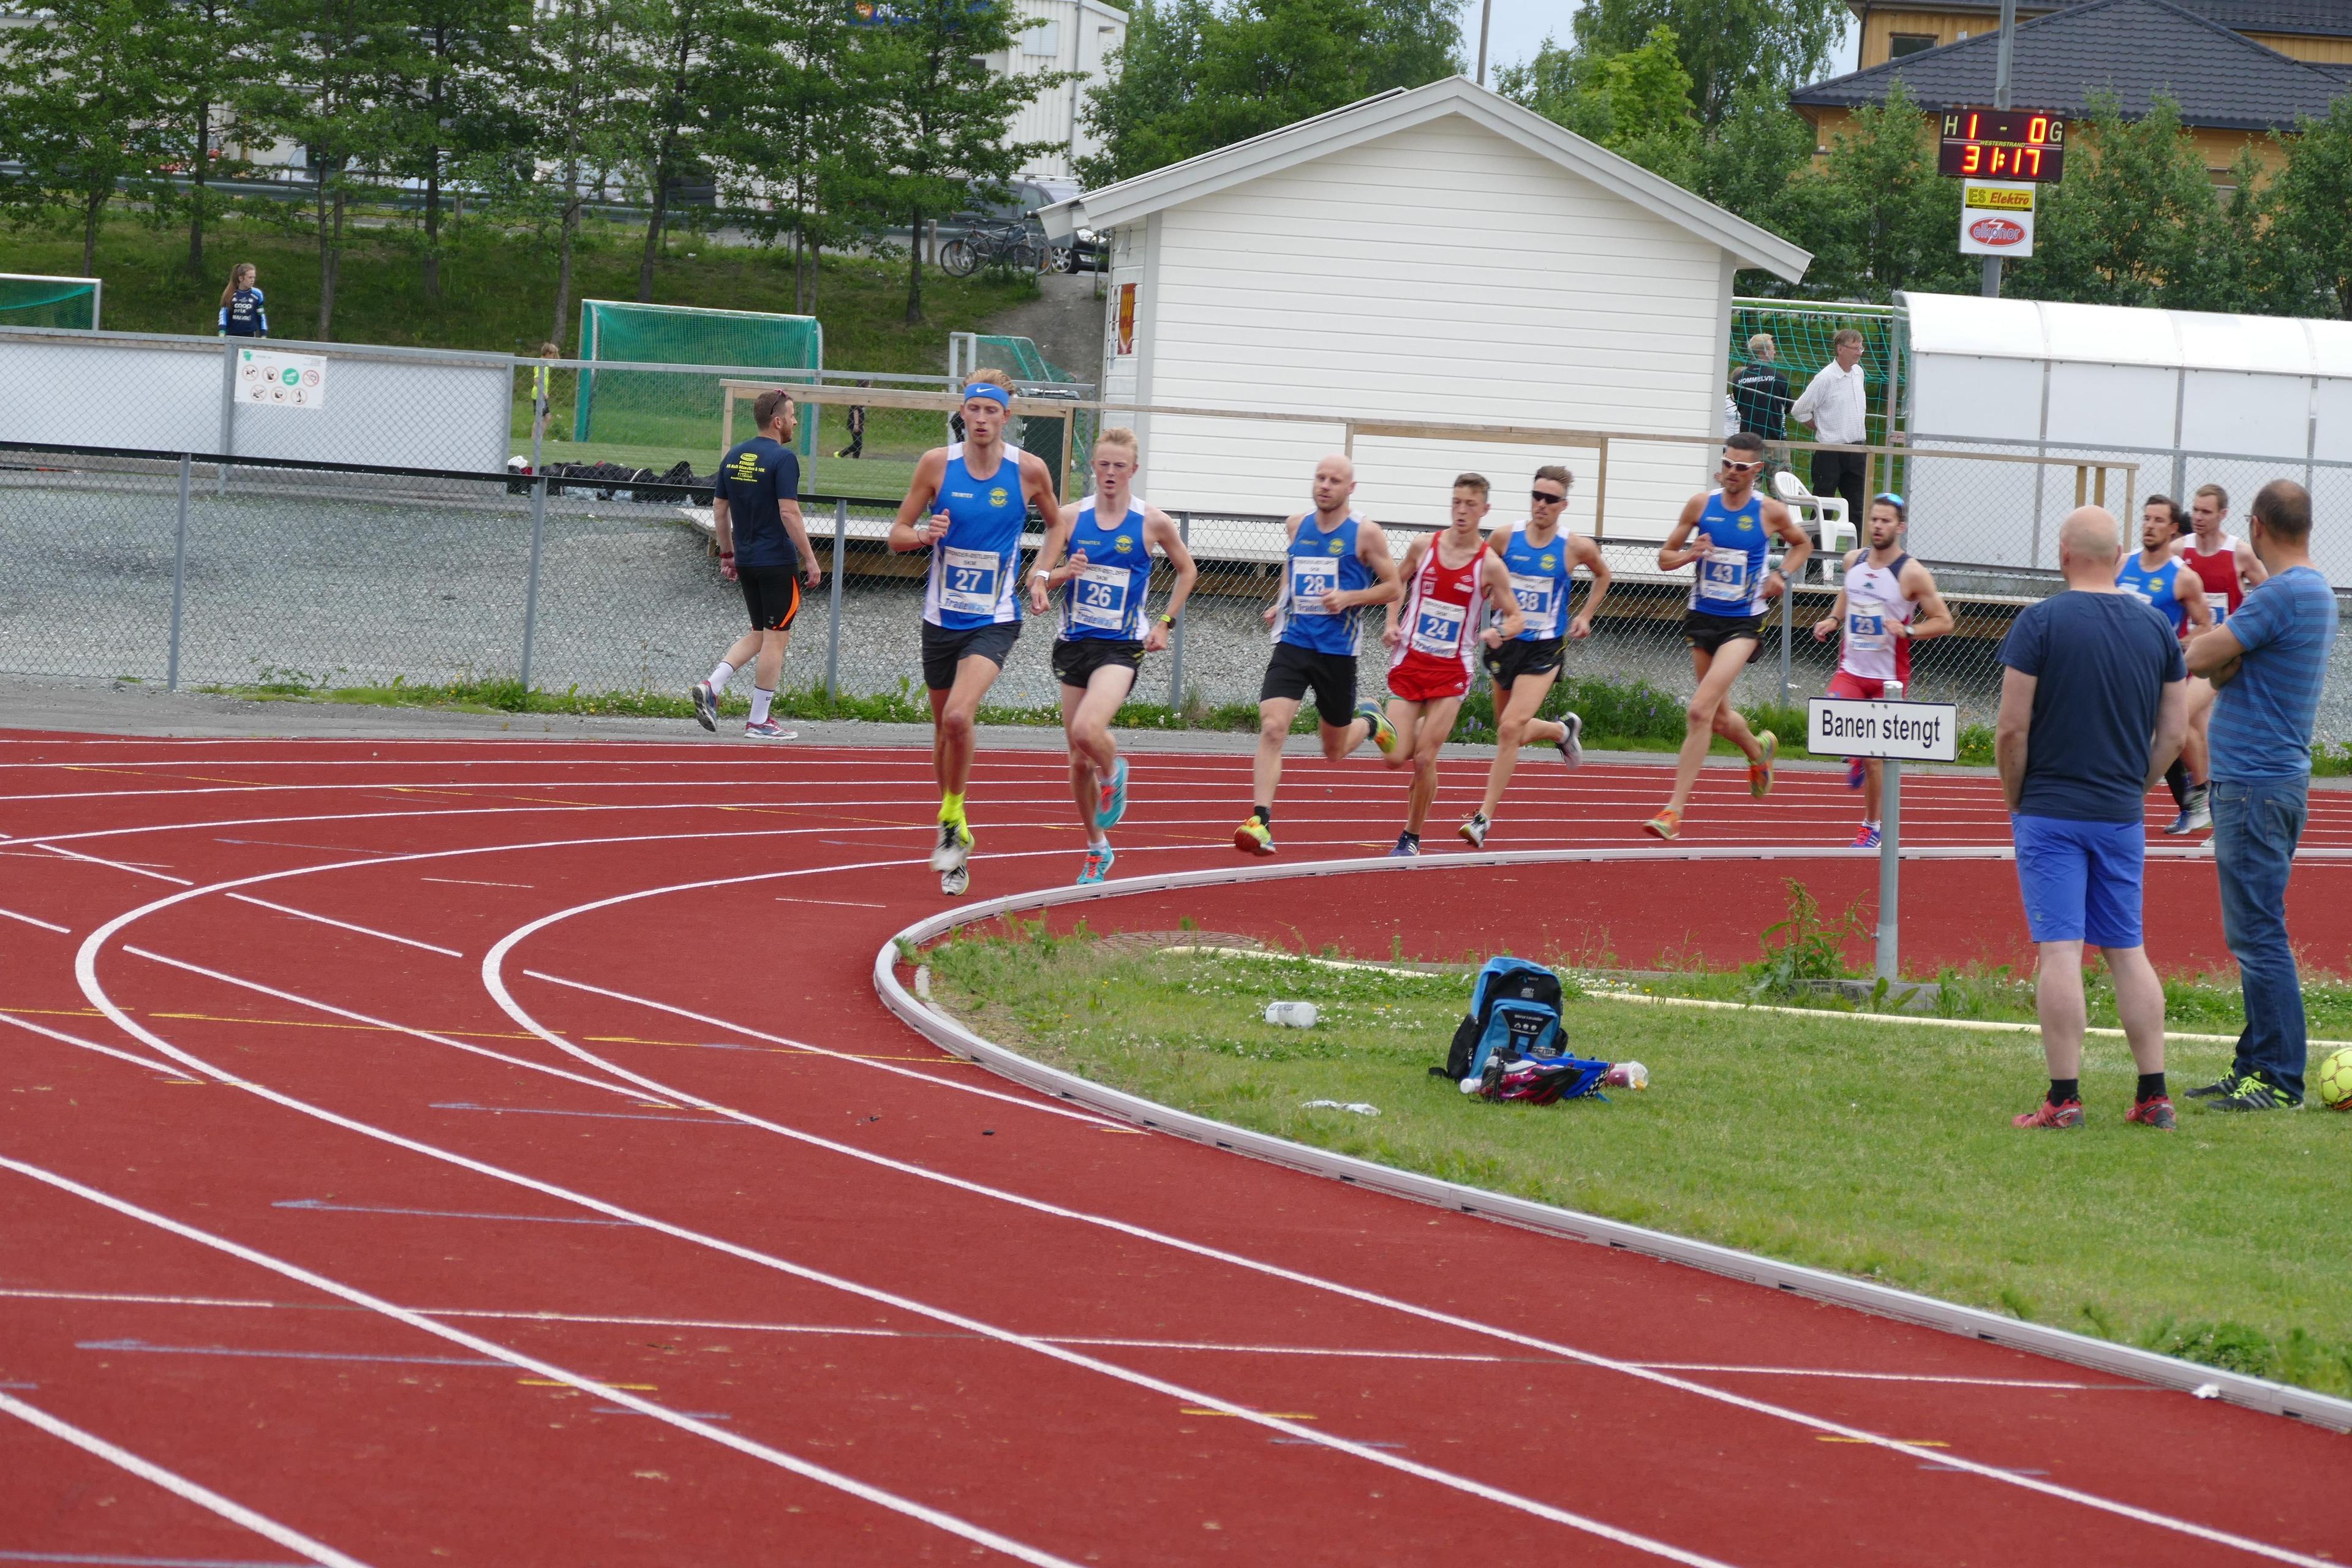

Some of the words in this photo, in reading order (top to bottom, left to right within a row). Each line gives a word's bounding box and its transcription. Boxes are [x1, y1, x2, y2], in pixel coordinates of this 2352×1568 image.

[1944, 115, 1958, 135] H
[1969, 113, 1978, 140] 1
[2029, 117, 2047, 143] 0
[2049, 121, 2064, 142] G
[1962, 145, 2041, 175] 31:17
[1969, 189, 1986, 203] ES
[1990, 192, 2029, 205] Elektro
[1974, 222, 2021, 240] elkonor
[1738, 375, 1776, 385] HOMMELVIK
[955, 569, 982, 591] 27
[1711, 564, 1733, 583] 43
[1086, 583, 1112, 607] 26
[1303, 575, 1326, 595] 28
[1517, 591, 1539, 611] 38
[1425, 617, 1450, 639] 24
[1855, 617, 1875, 634] 23
[1822, 709, 1876, 739] Banen
[1882, 714, 1940, 748] stengt
